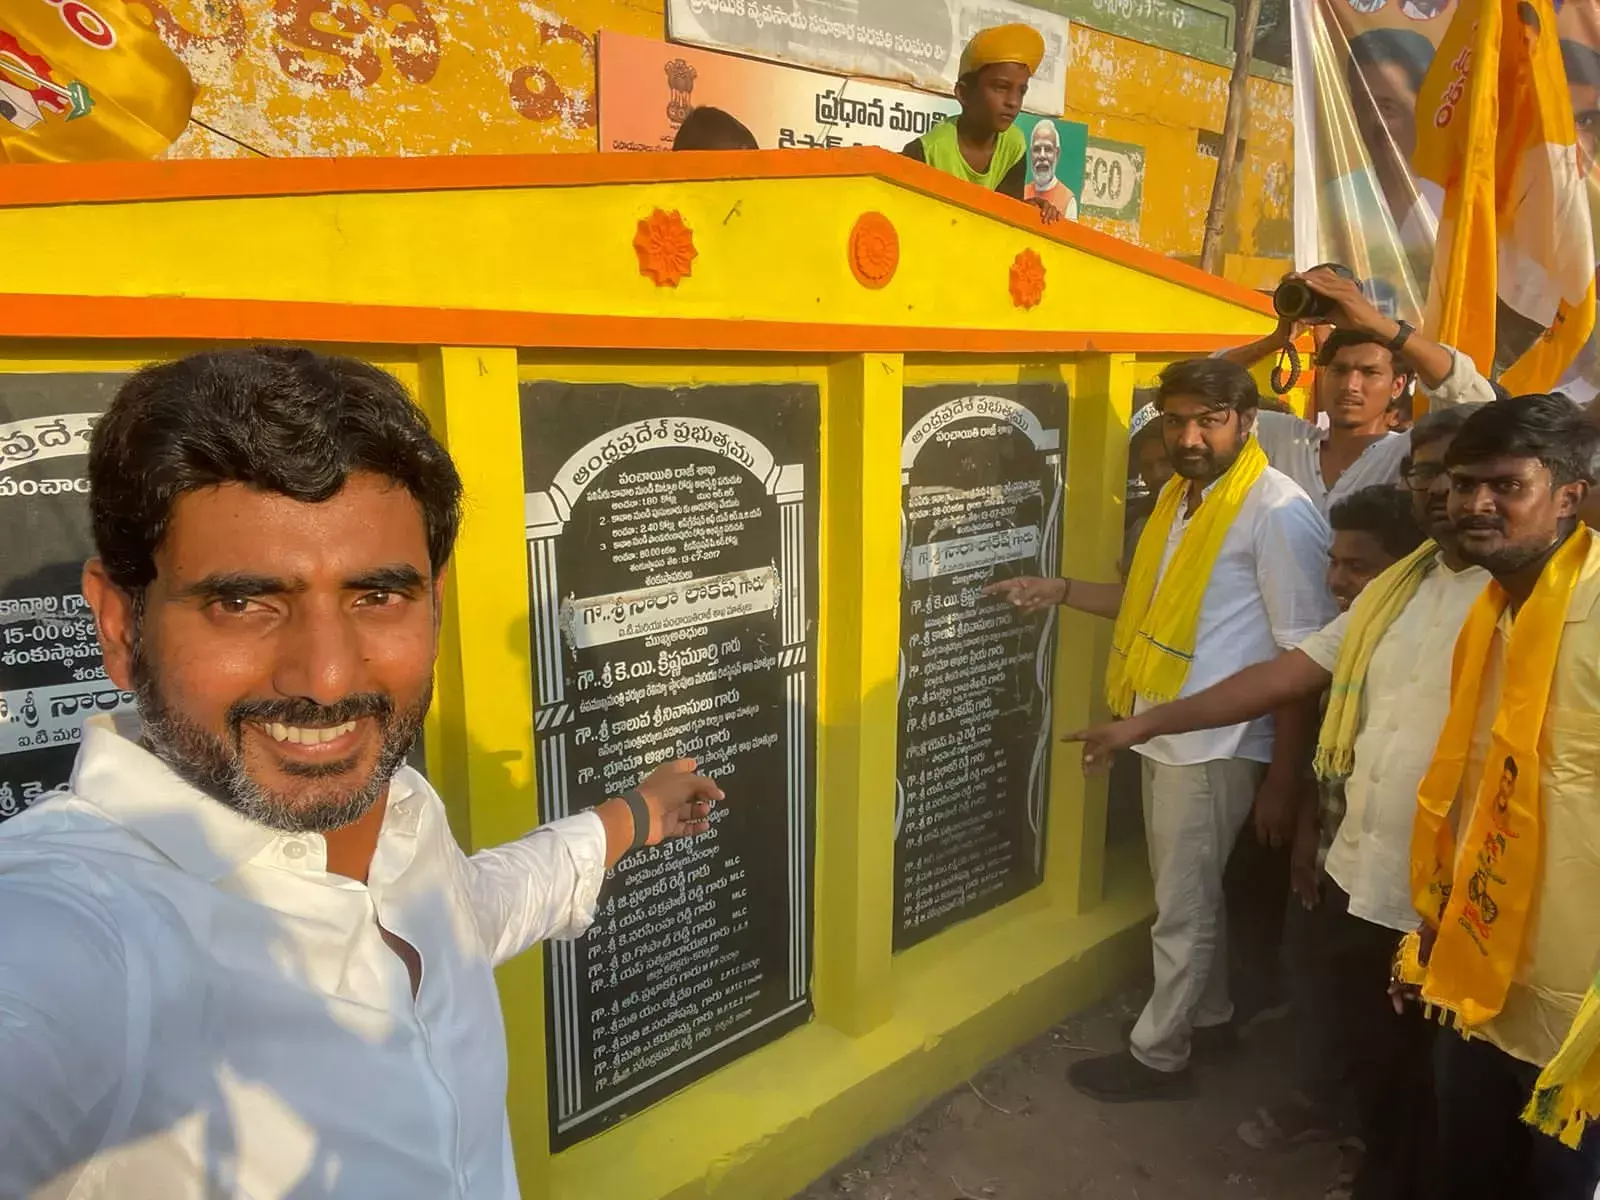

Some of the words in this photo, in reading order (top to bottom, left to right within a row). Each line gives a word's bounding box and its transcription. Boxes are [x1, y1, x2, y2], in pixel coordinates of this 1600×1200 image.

[815, 89, 884, 128] ప్రధాన
[572, 419, 669, 486] ఆంధ్రప్రదేశ్
[673, 421, 755, 469] ప్రభుత్వము
[674, 463, 694, 478] రాజ్
[3, 626, 59, 644] 15-00
[720, 636, 740, 655] గారు
[714, 687, 739, 708] గారు
[705, 727, 730, 747] గారు
[695, 827, 717, 844] గారు
